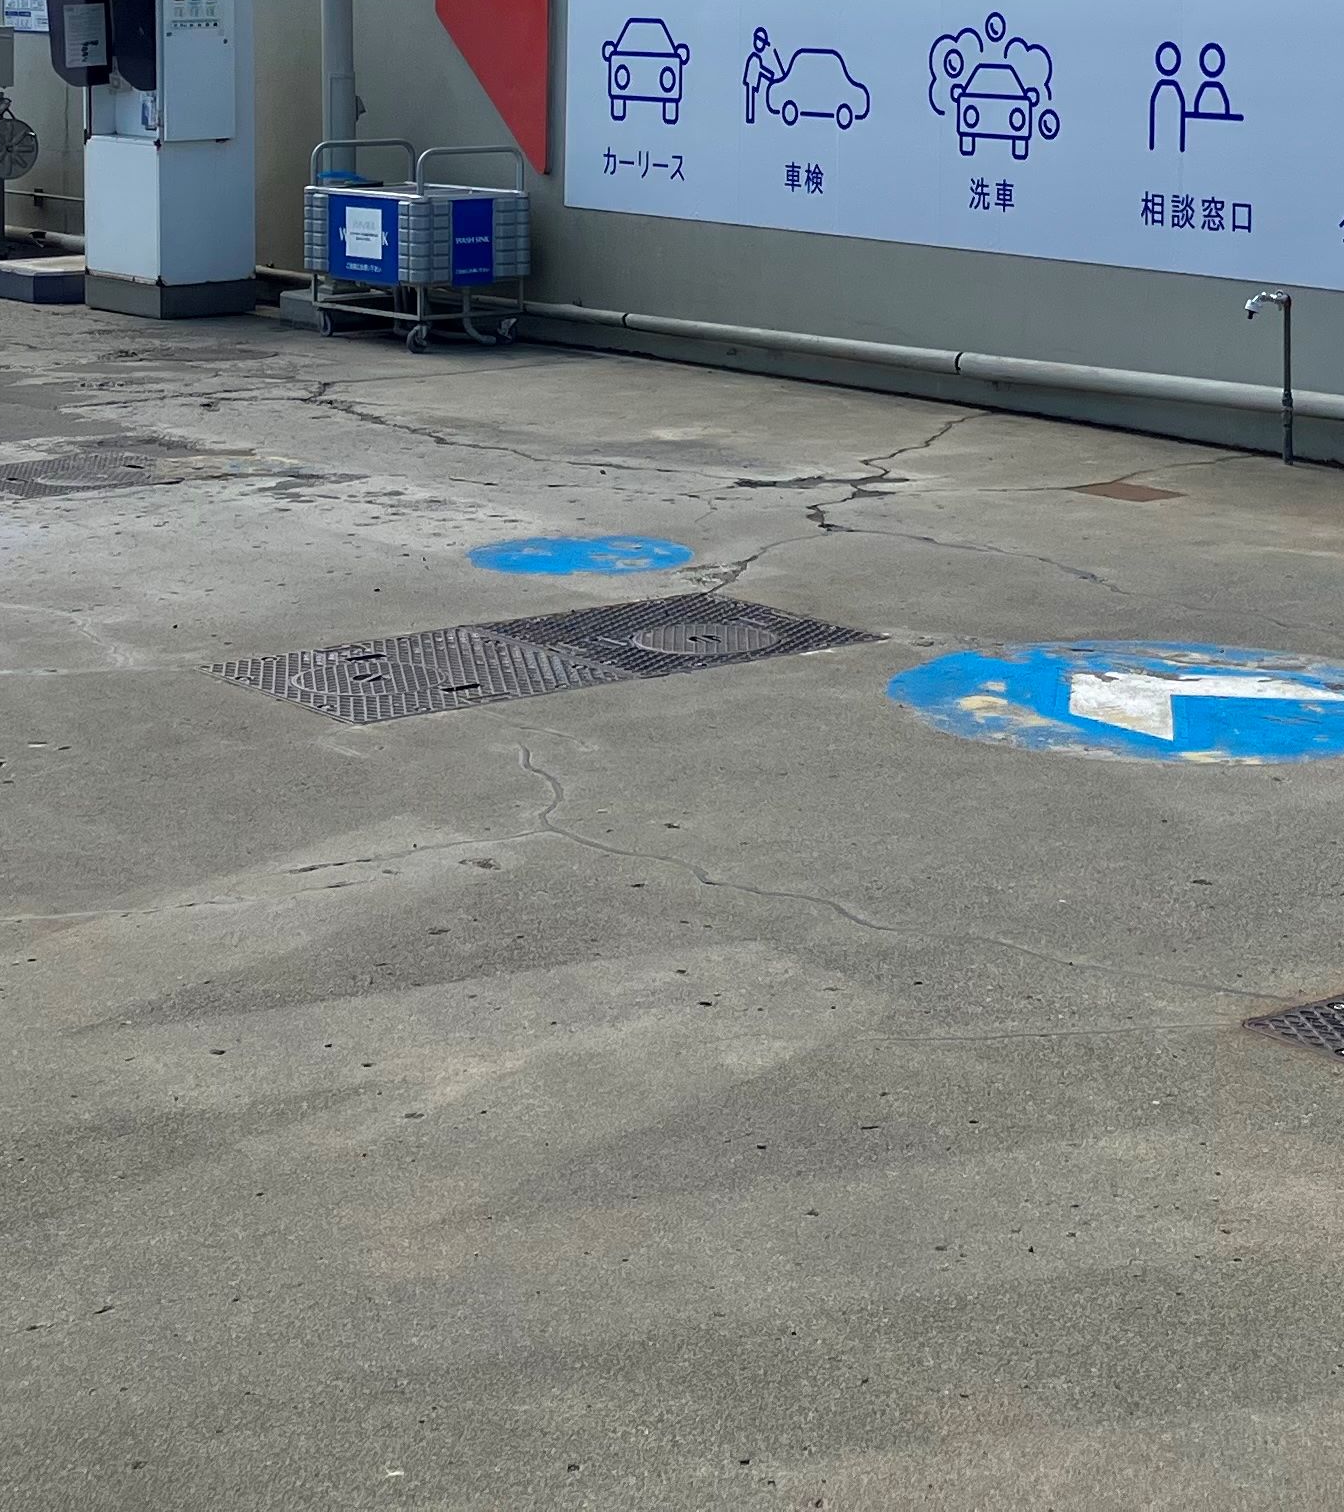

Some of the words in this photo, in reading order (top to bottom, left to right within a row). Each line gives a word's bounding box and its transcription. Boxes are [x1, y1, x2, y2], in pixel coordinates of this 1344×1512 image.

[603, 147, 684, 181] カーリース
[785, 162, 823, 194] 車検
[969, 177, 1014, 212] 洗車
[1141, 191, 1251, 233] 相談窓口
